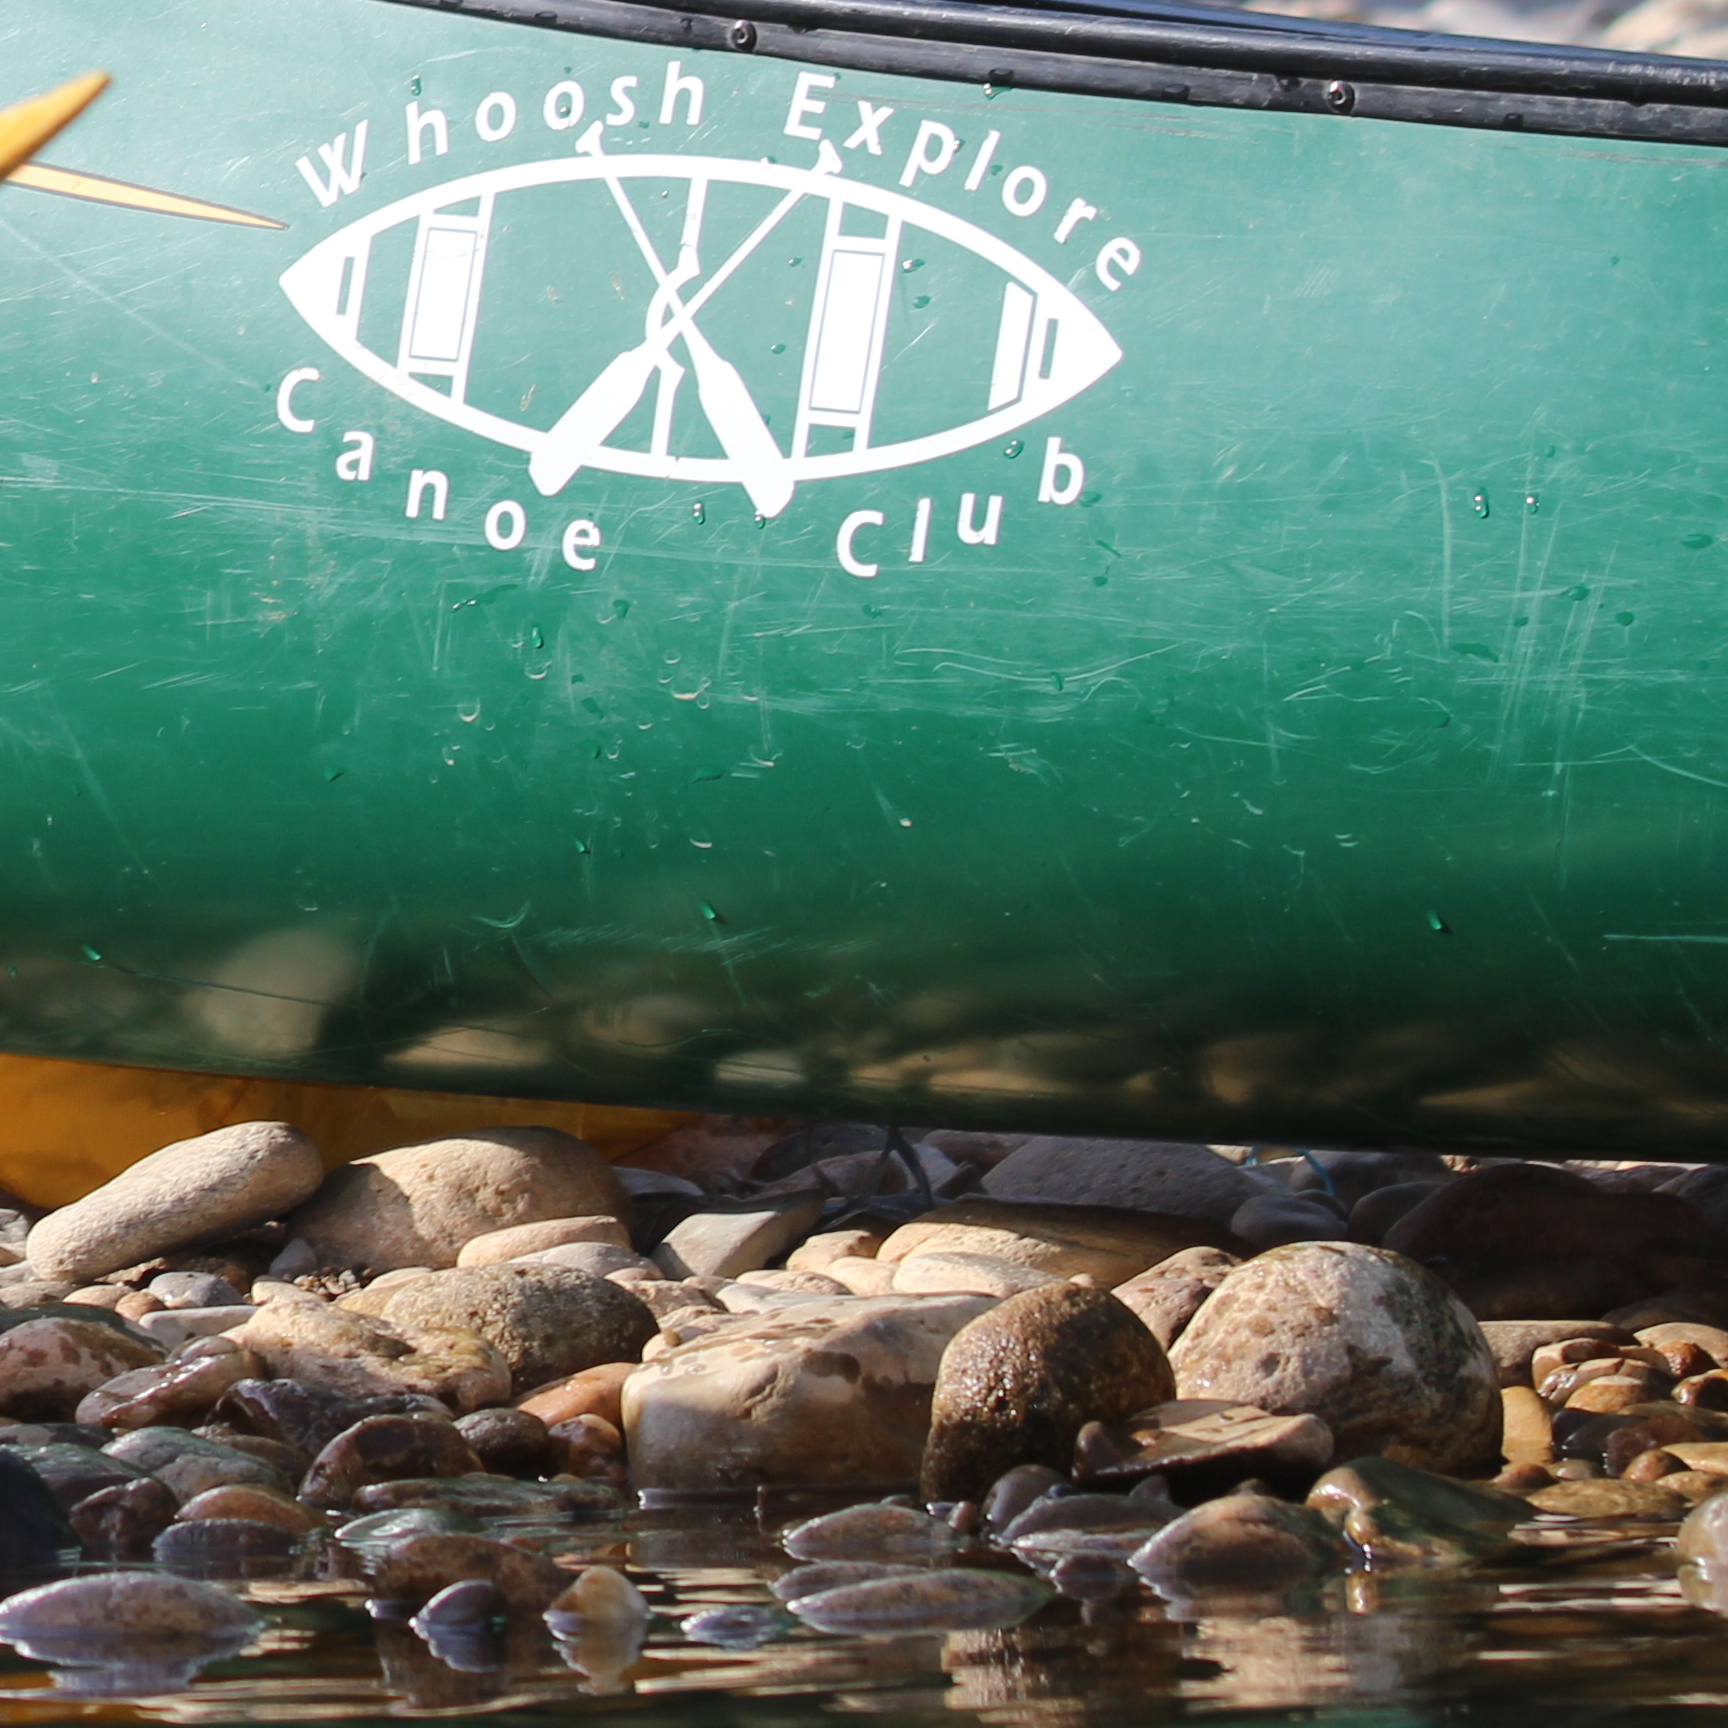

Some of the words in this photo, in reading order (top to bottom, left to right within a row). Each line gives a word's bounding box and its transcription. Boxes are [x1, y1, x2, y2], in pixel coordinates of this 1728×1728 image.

[295, 60, 706, 208] Whoosh
[784, 71, 1142, 292] Explore
[275, 366, 603, 572] Canoe
[837, 438, 1086, 579] Club
